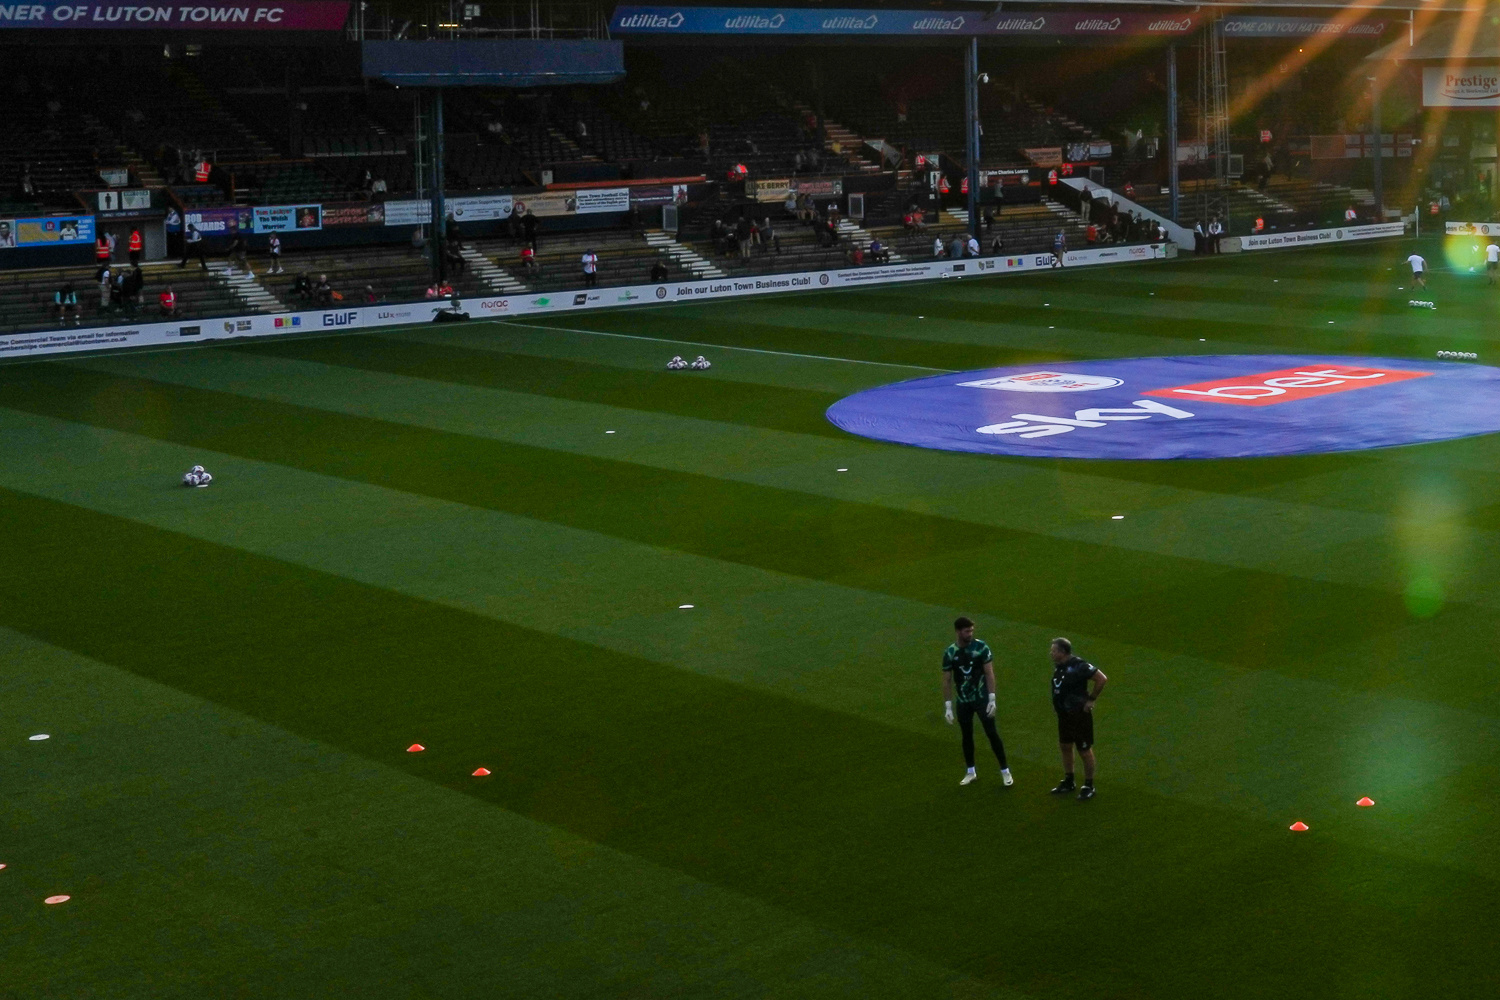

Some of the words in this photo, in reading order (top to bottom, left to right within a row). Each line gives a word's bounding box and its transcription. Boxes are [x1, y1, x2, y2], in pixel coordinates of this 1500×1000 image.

[52, 5, 88, 21] OF
[93, 6, 172, 22] LUTON
[179, 7, 249, 22] TOWN
[254, 8, 285, 23] FC
[620, 14, 668, 28] utilita
[725, 15, 771, 28] utilita
[822, 16, 865, 29] utilita
[913, 17, 952, 30] utilita
[996, 18, 1033, 30] utilita
[1075, 19, 1109, 30] utilita
[1148, 20, 1180, 31] utilita
[1224, 22, 1257, 33] COME
[1258, 22, 1276, 33] ON
[1277, 23, 1299, 33] YOU
[1299, 23, 1344, 34] HATTERS!
[1445, 74, 1498, 90] Prestige
[767, 182, 788, 190] BERRY
[676, 287, 692, 295] Join
[694, 286, 708, 294] our
[710, 284, 732, 293] Luton
[733, 282, 754, 291] Town
[756, 279, 789, 289] Business
[791, 277, 811, 287] Club!
[480, 299, 508, 309] norac
[323, 312, 358, 326] GWF
[10, 336, 48, 345] Commercial
[975, 399, 1195, 439] sky
[1172, 369, 1386, 400] bet
